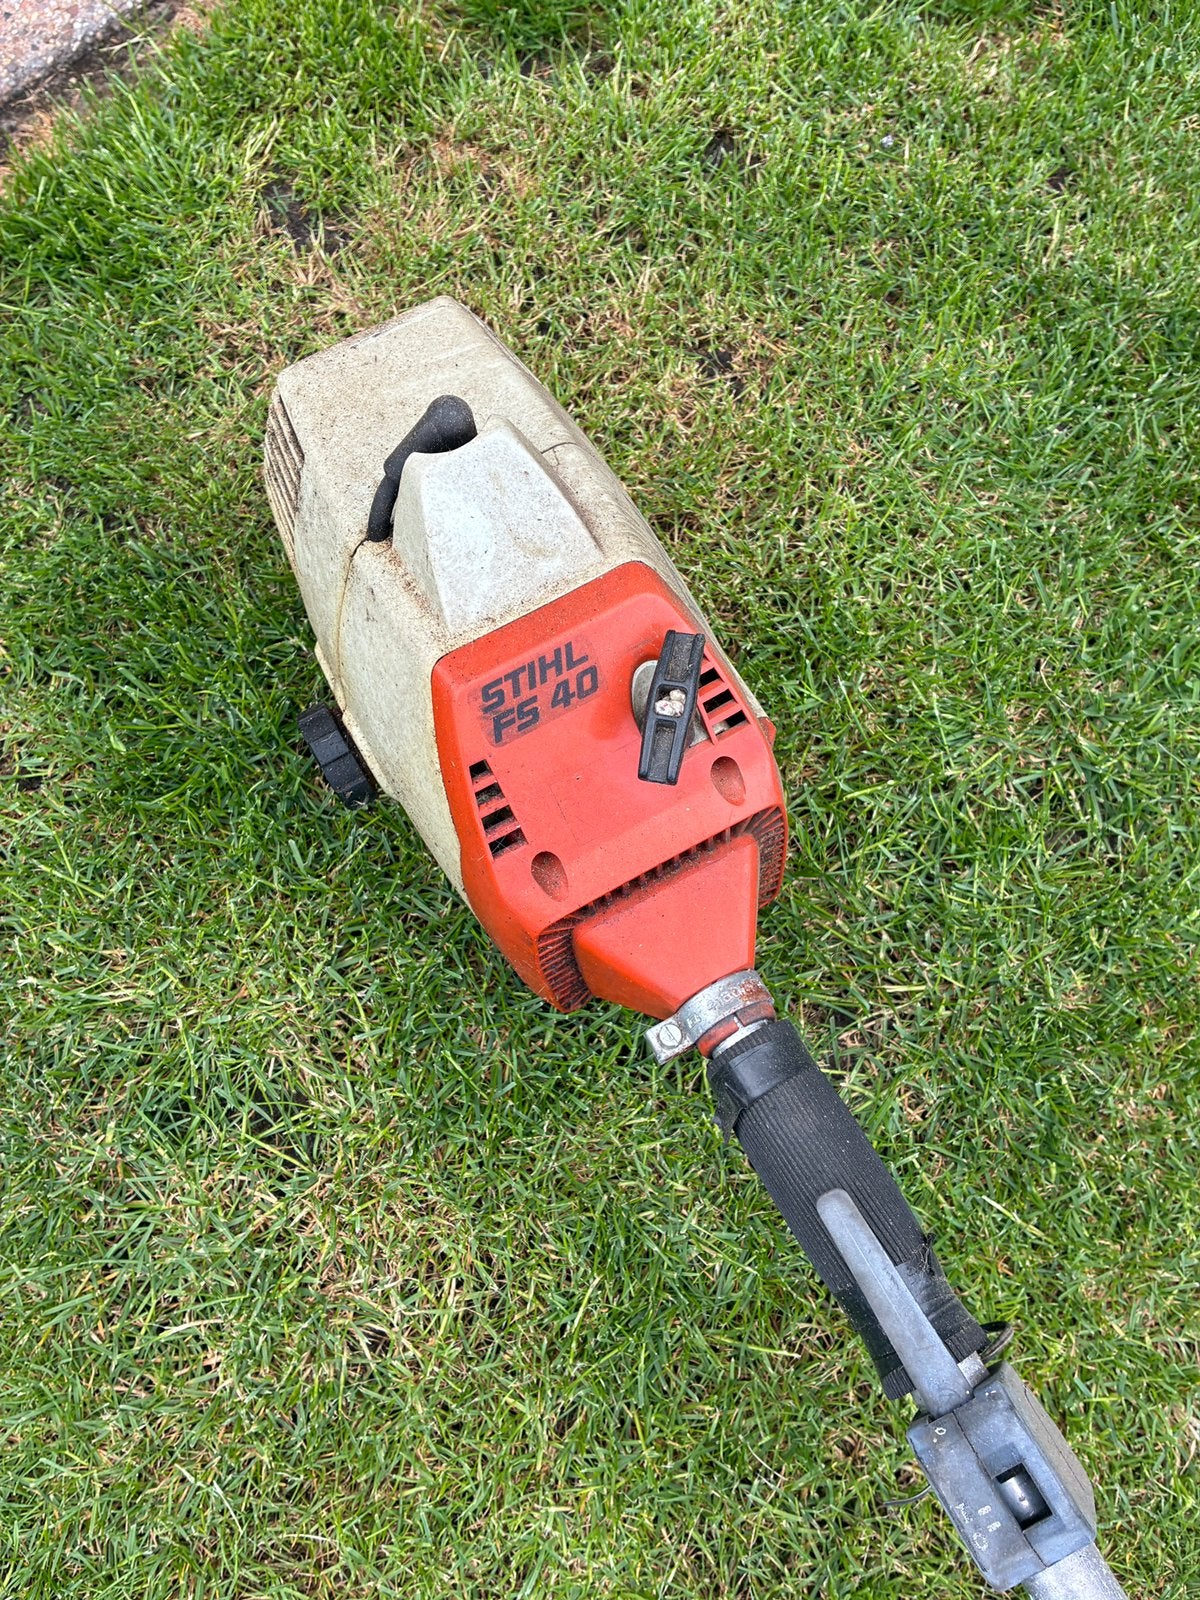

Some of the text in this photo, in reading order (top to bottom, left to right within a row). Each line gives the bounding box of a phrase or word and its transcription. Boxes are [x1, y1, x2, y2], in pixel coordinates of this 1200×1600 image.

[481, 641, 589, 714] STIHL
[492, 665, 598, 744] FS 40
